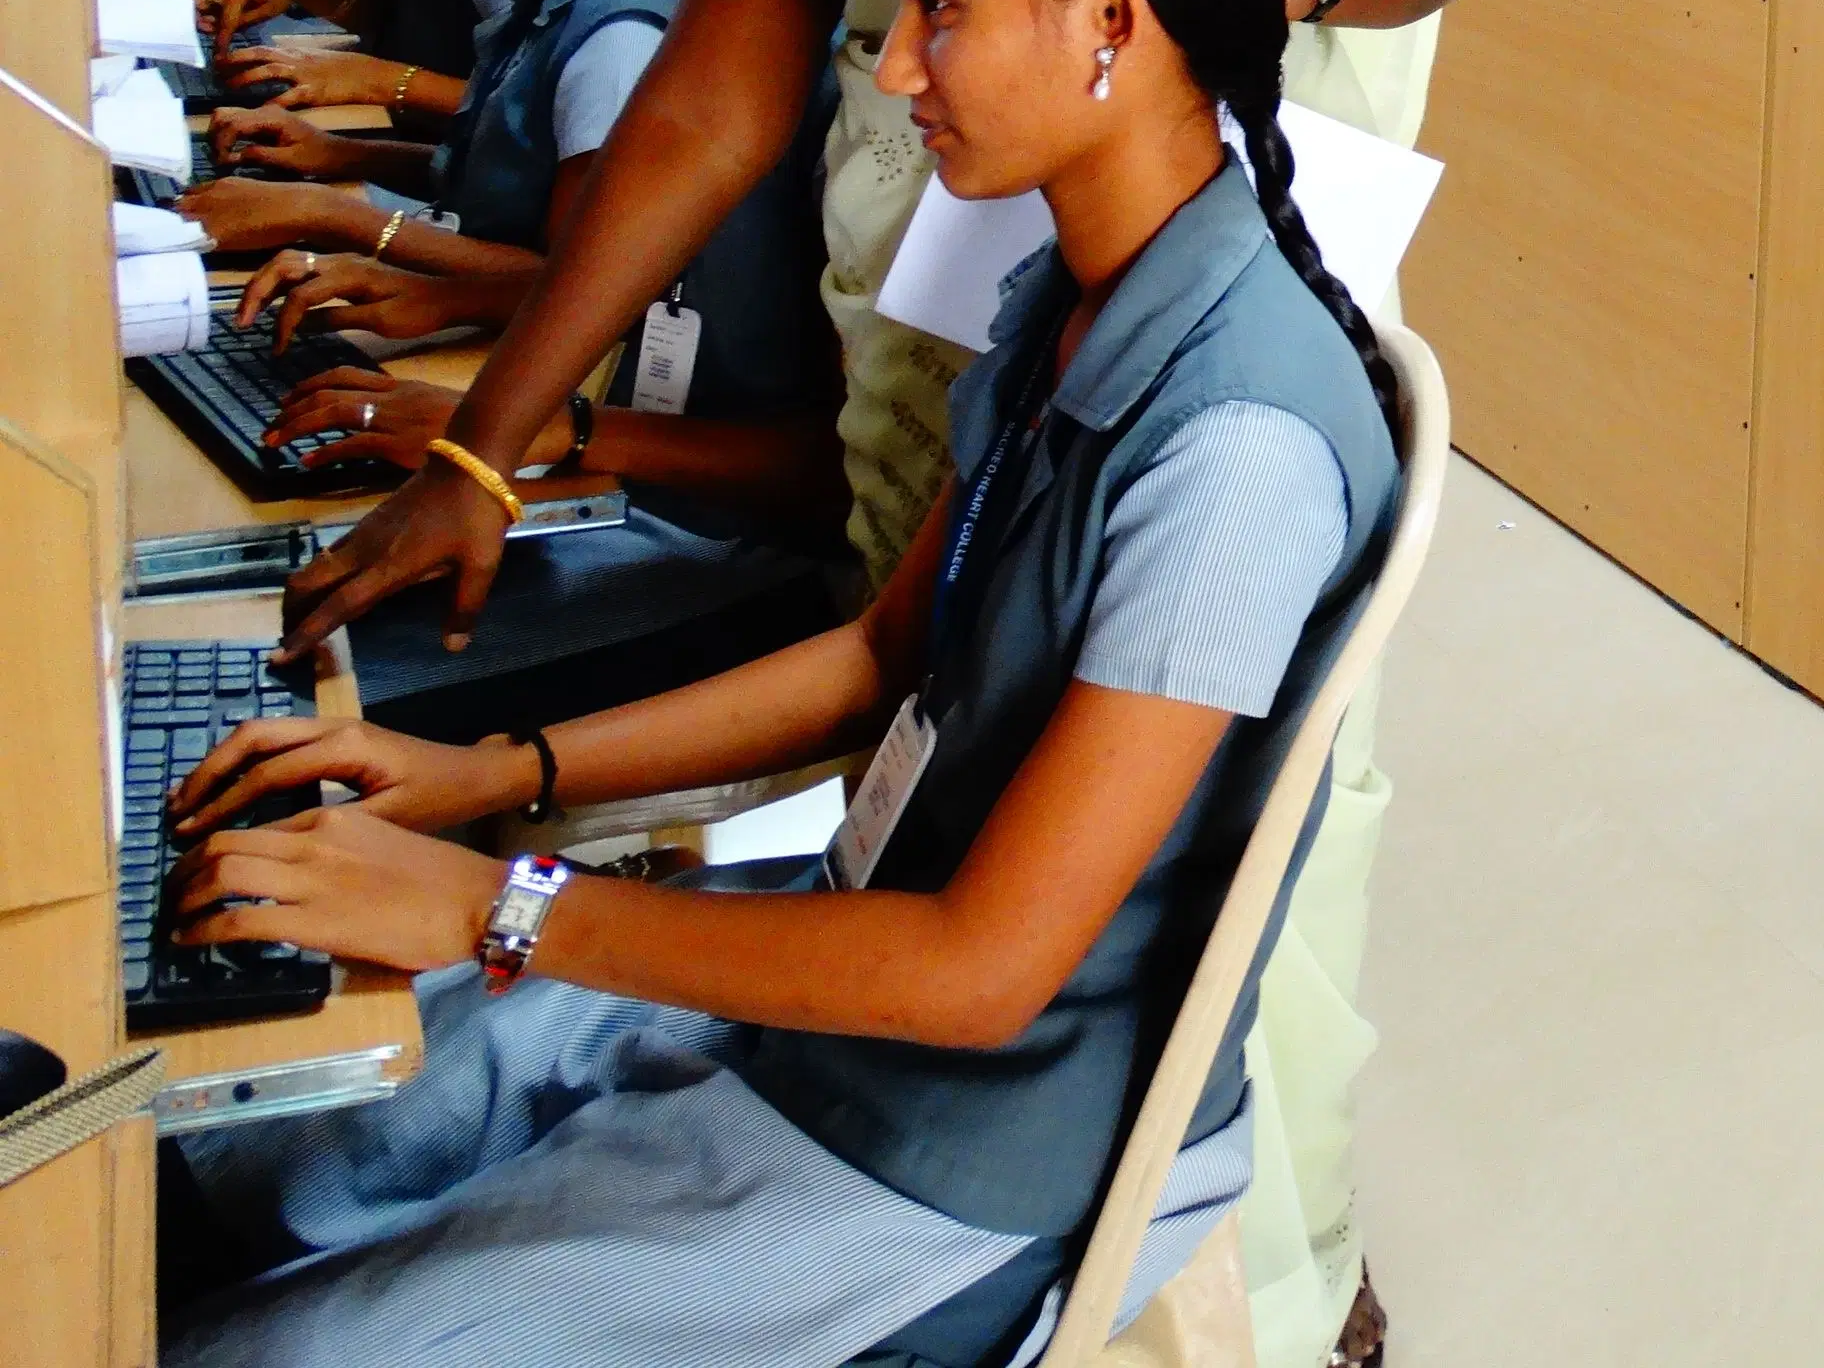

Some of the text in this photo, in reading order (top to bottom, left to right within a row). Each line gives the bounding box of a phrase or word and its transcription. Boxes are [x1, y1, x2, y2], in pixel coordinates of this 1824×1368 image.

[947, 420, 1016, 582] SACRED HEART COLLEGE
